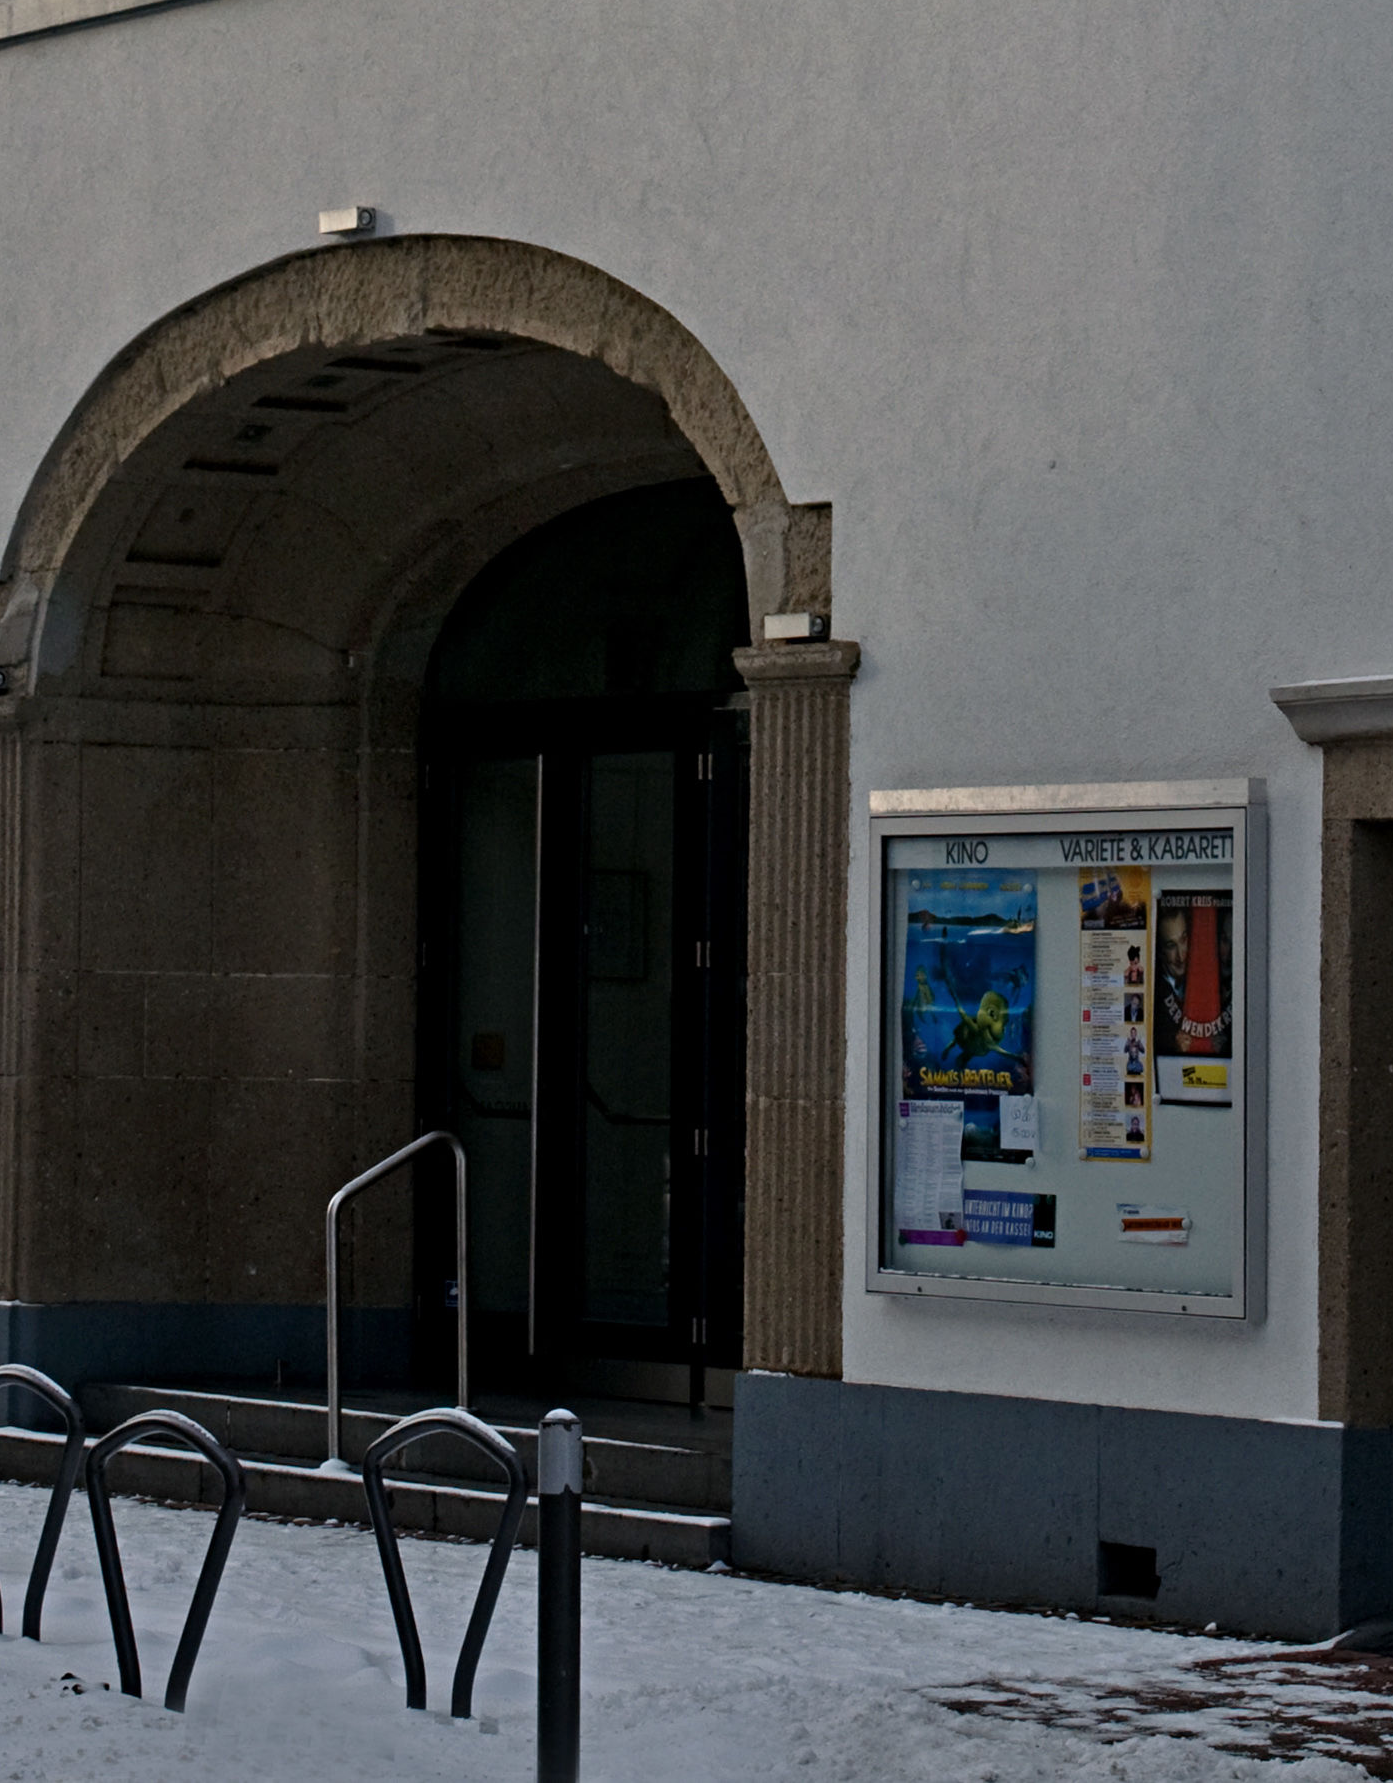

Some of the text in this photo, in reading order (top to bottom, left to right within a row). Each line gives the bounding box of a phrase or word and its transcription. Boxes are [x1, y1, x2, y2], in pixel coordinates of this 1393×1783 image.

[945, 840, 989, 865] KINO
[1130, 837, 1144, 861] &
[1148, 835, 1233, 860] KABARETT
[1001, 1201, 1011, 1217] IM
[1011, 1202, 1034, 1219] KINO?
[981, 1220, 989, 1234] AN
[990, 1220, 1004, 1235] DER
[1033, 1230, 1054, 1240] KINO
